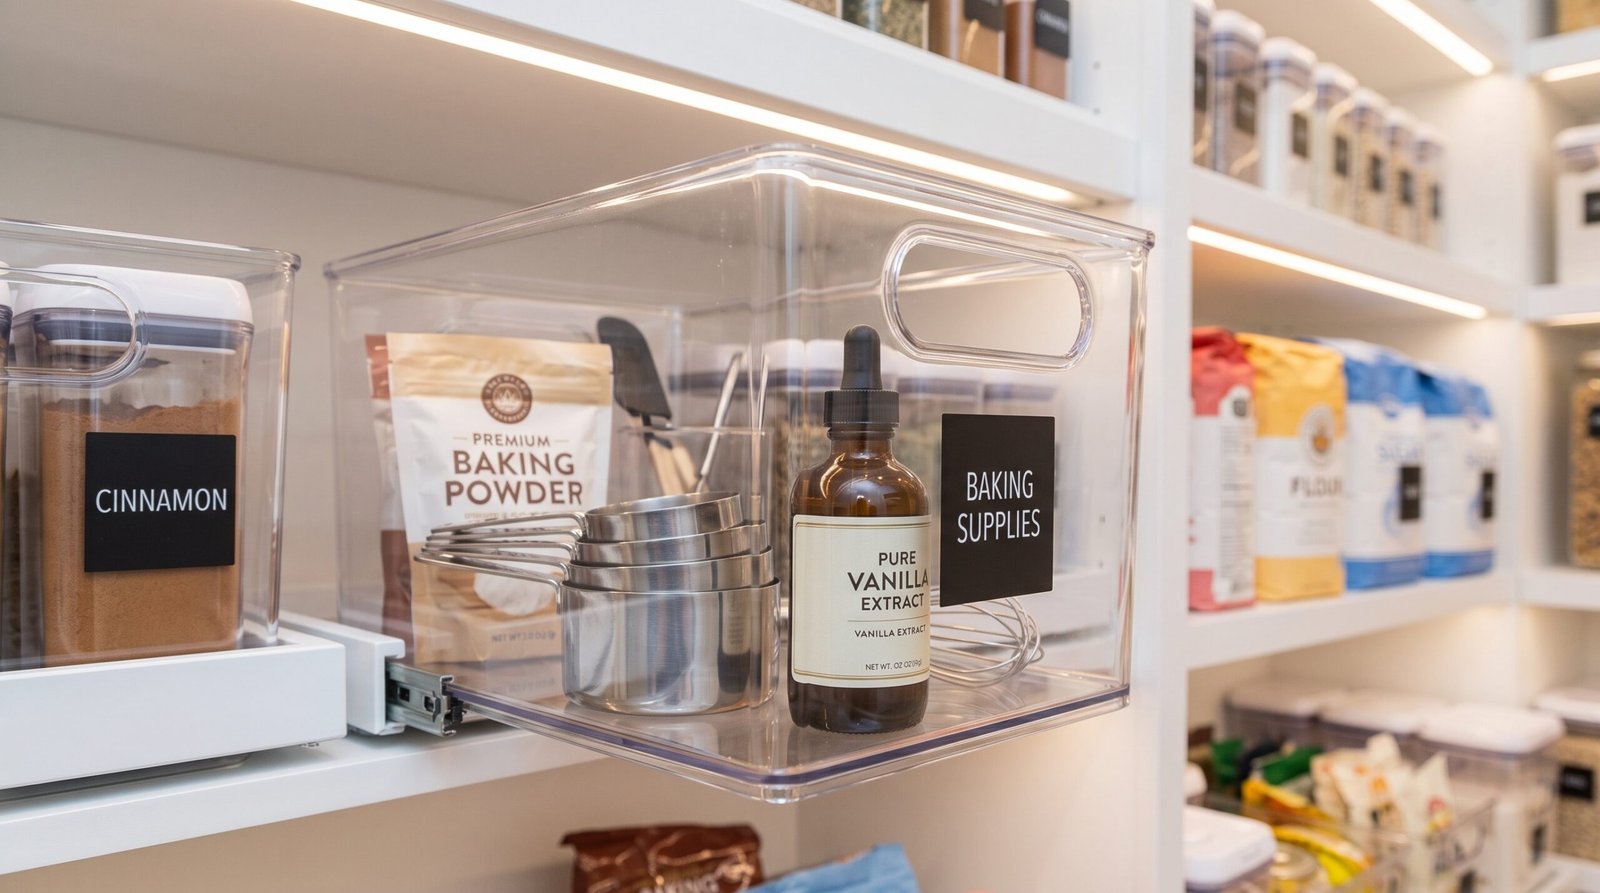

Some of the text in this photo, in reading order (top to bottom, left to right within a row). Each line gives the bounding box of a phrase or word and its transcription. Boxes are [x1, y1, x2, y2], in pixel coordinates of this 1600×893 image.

[473, 433, 551, 447] PREMIUM
[453, 450, 575, 475] BAKING
[445, 480, 583, 506] POWDER
[967, 469, 1034, 501] BAKING
[95, 488, 227, 513] CINNAMON
[957, 508, 1041, 544] SUPPLIES
[878, 550, 917, 566] PURE
[847, 568, 929, 591] VANILLA
[861, 593, 924, 611] EXTRACT
[854, 624, 927, 638] VANILLA EXTRACT
[865, 663, 879, 671] NET
